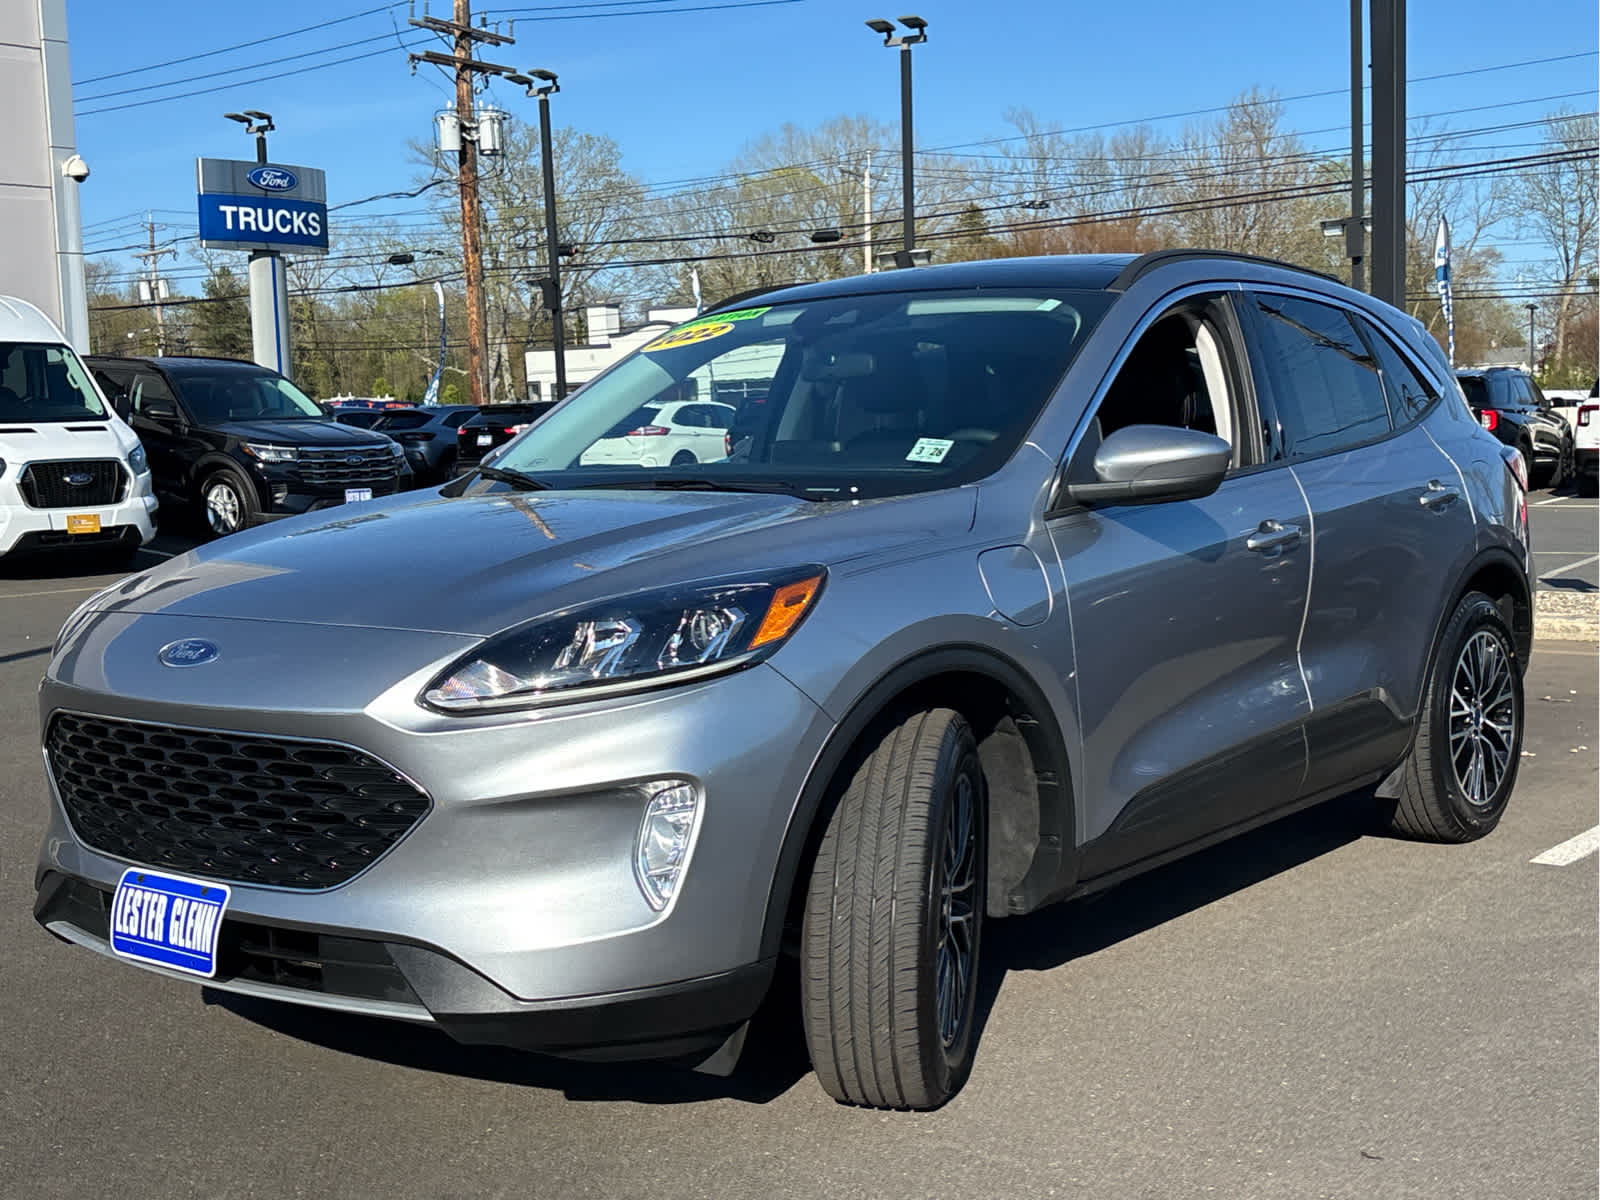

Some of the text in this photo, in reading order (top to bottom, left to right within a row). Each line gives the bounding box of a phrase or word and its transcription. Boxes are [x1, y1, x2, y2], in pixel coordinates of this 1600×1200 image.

[260, 170, 289, 188] Ford
[219, 205, 321, 236] TRUCKS
[645, 324, 730, 349] 2022
[915, 446, 925, 455] 3
[168, 642, 206, 660] Ford
[115, 886, 219, 954] LESTER GLENN
